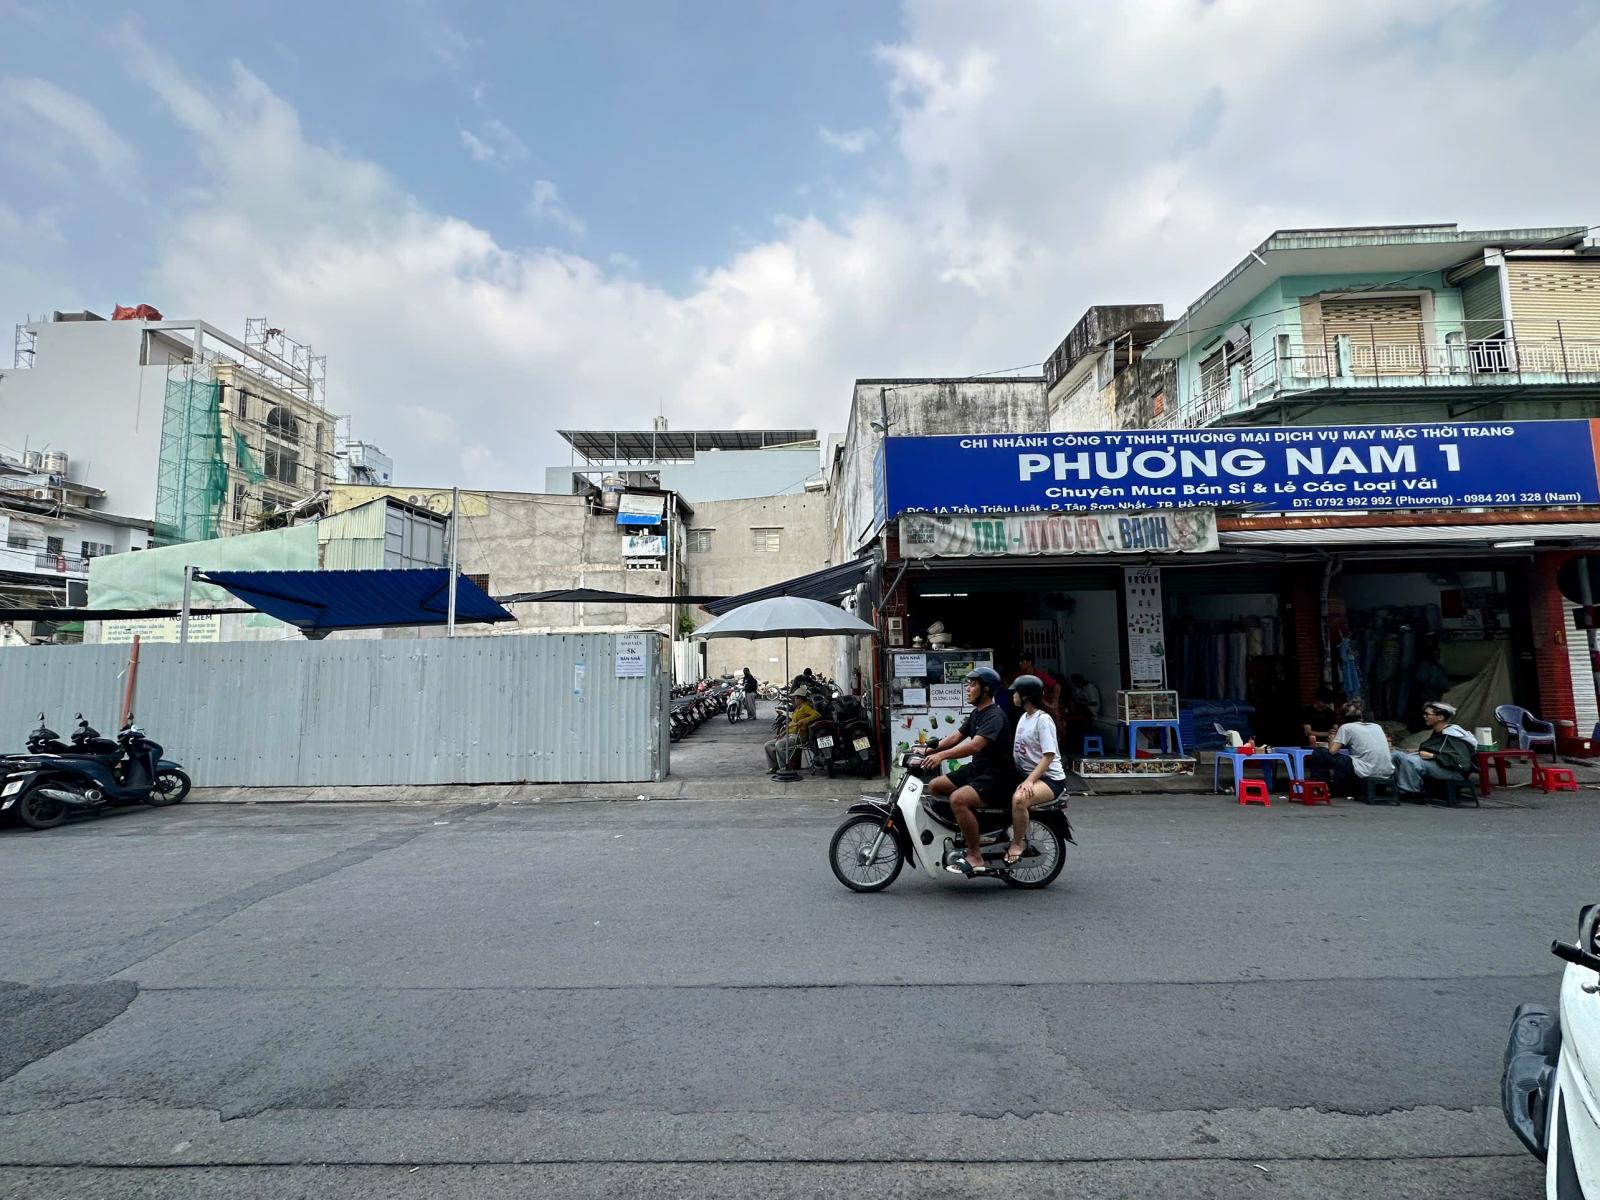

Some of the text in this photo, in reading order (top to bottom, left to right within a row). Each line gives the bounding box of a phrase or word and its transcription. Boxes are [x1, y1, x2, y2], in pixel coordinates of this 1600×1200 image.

[960, 426, 1515, 448] CHI NHÁNH CÔNG TY TNHH THƯƠNG MẠI DỊCH VỤ MAY MẶC THỜI TRANG
[1018, 443, 1460, 481] PHƯƠNG NAM 1
[1045, 477, 1438, 499] Chuyên Mua Bán Sỉ & Lẻ Các Loại Vải
[932, 506, 948, 514] 1A
[1293, 498, 1312, 508] ĐT:
[1315, 497, 1344, 507] 0792
[1346, 497, 1368, 506] 992
[1371, 496, 1392, 505] 992
[1395, 494, 1453, 506] (Phương)
[1464, 493, 1492, 503] 0984
[1495, 493, 1516, 503] 201
[1520, 493, 1541, 502] 328
[1545, 492, 1581, 503] (Nam)
